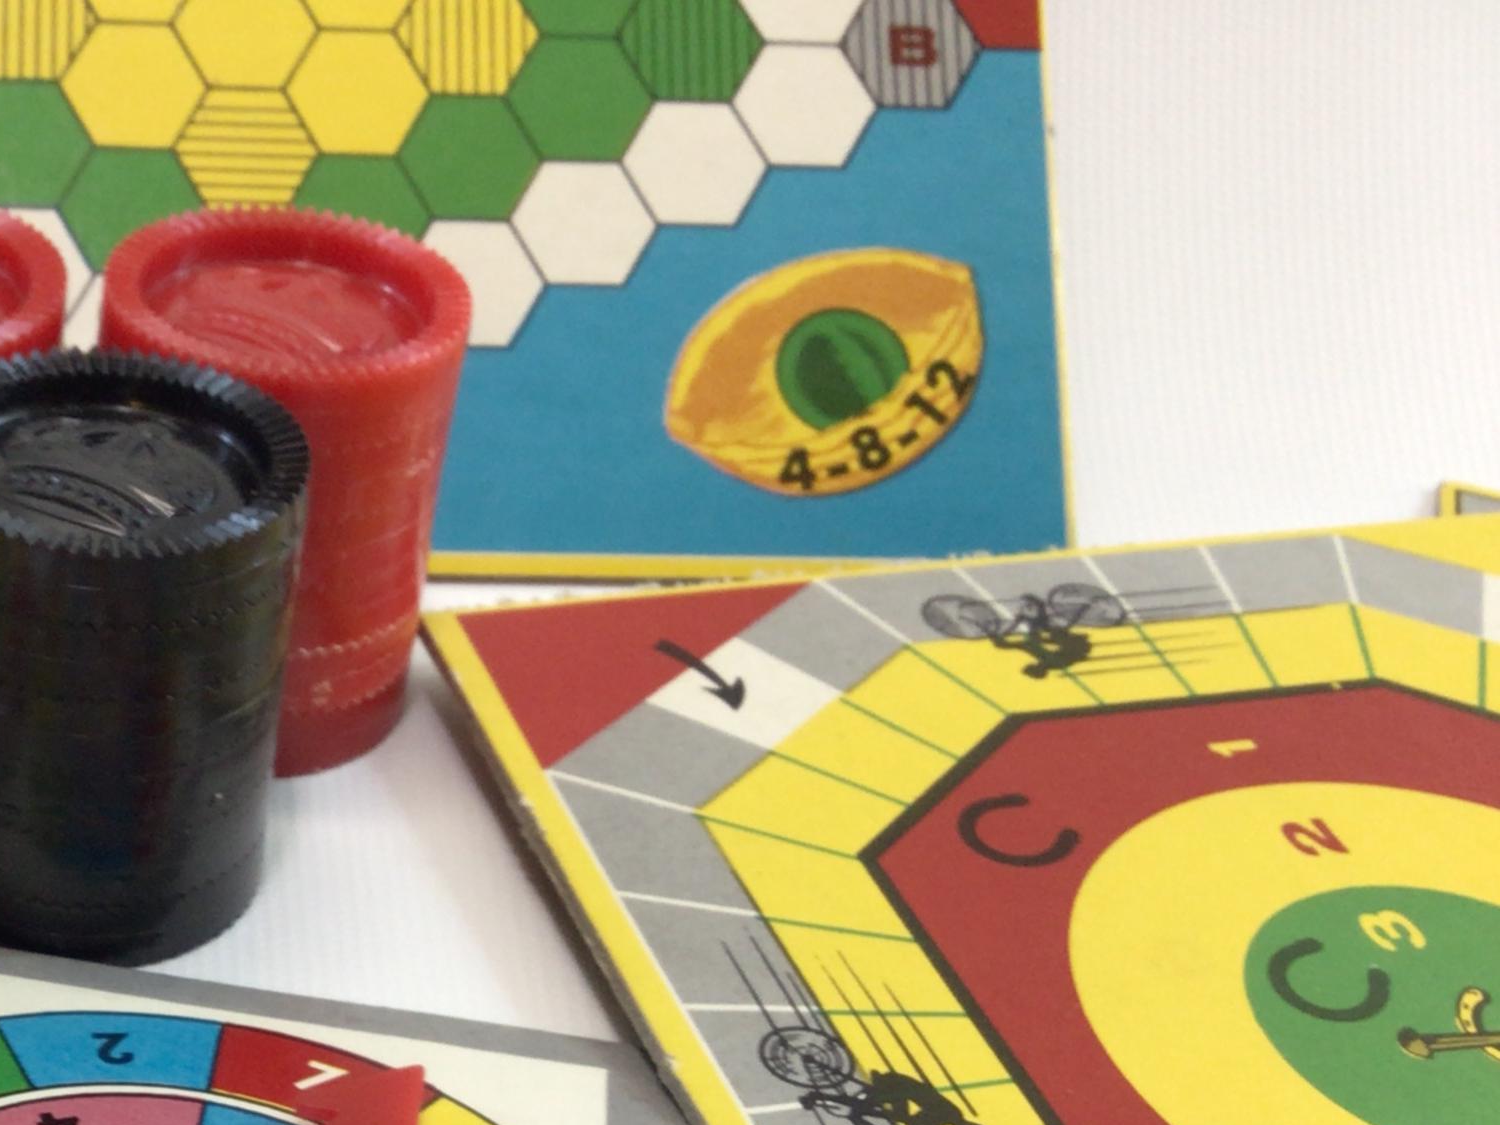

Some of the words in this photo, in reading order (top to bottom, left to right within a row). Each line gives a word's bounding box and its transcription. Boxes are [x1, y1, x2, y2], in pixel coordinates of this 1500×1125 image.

[888, 24, 938, 68] B
[779, 360, 977, 490] 4-8-12
[1280, 817, 1350, 856] 2
[1358, 908, 1427, 951] 3
[91, 1032, 135, 1066] 2
[294, 1060, 349, 1091] 7
